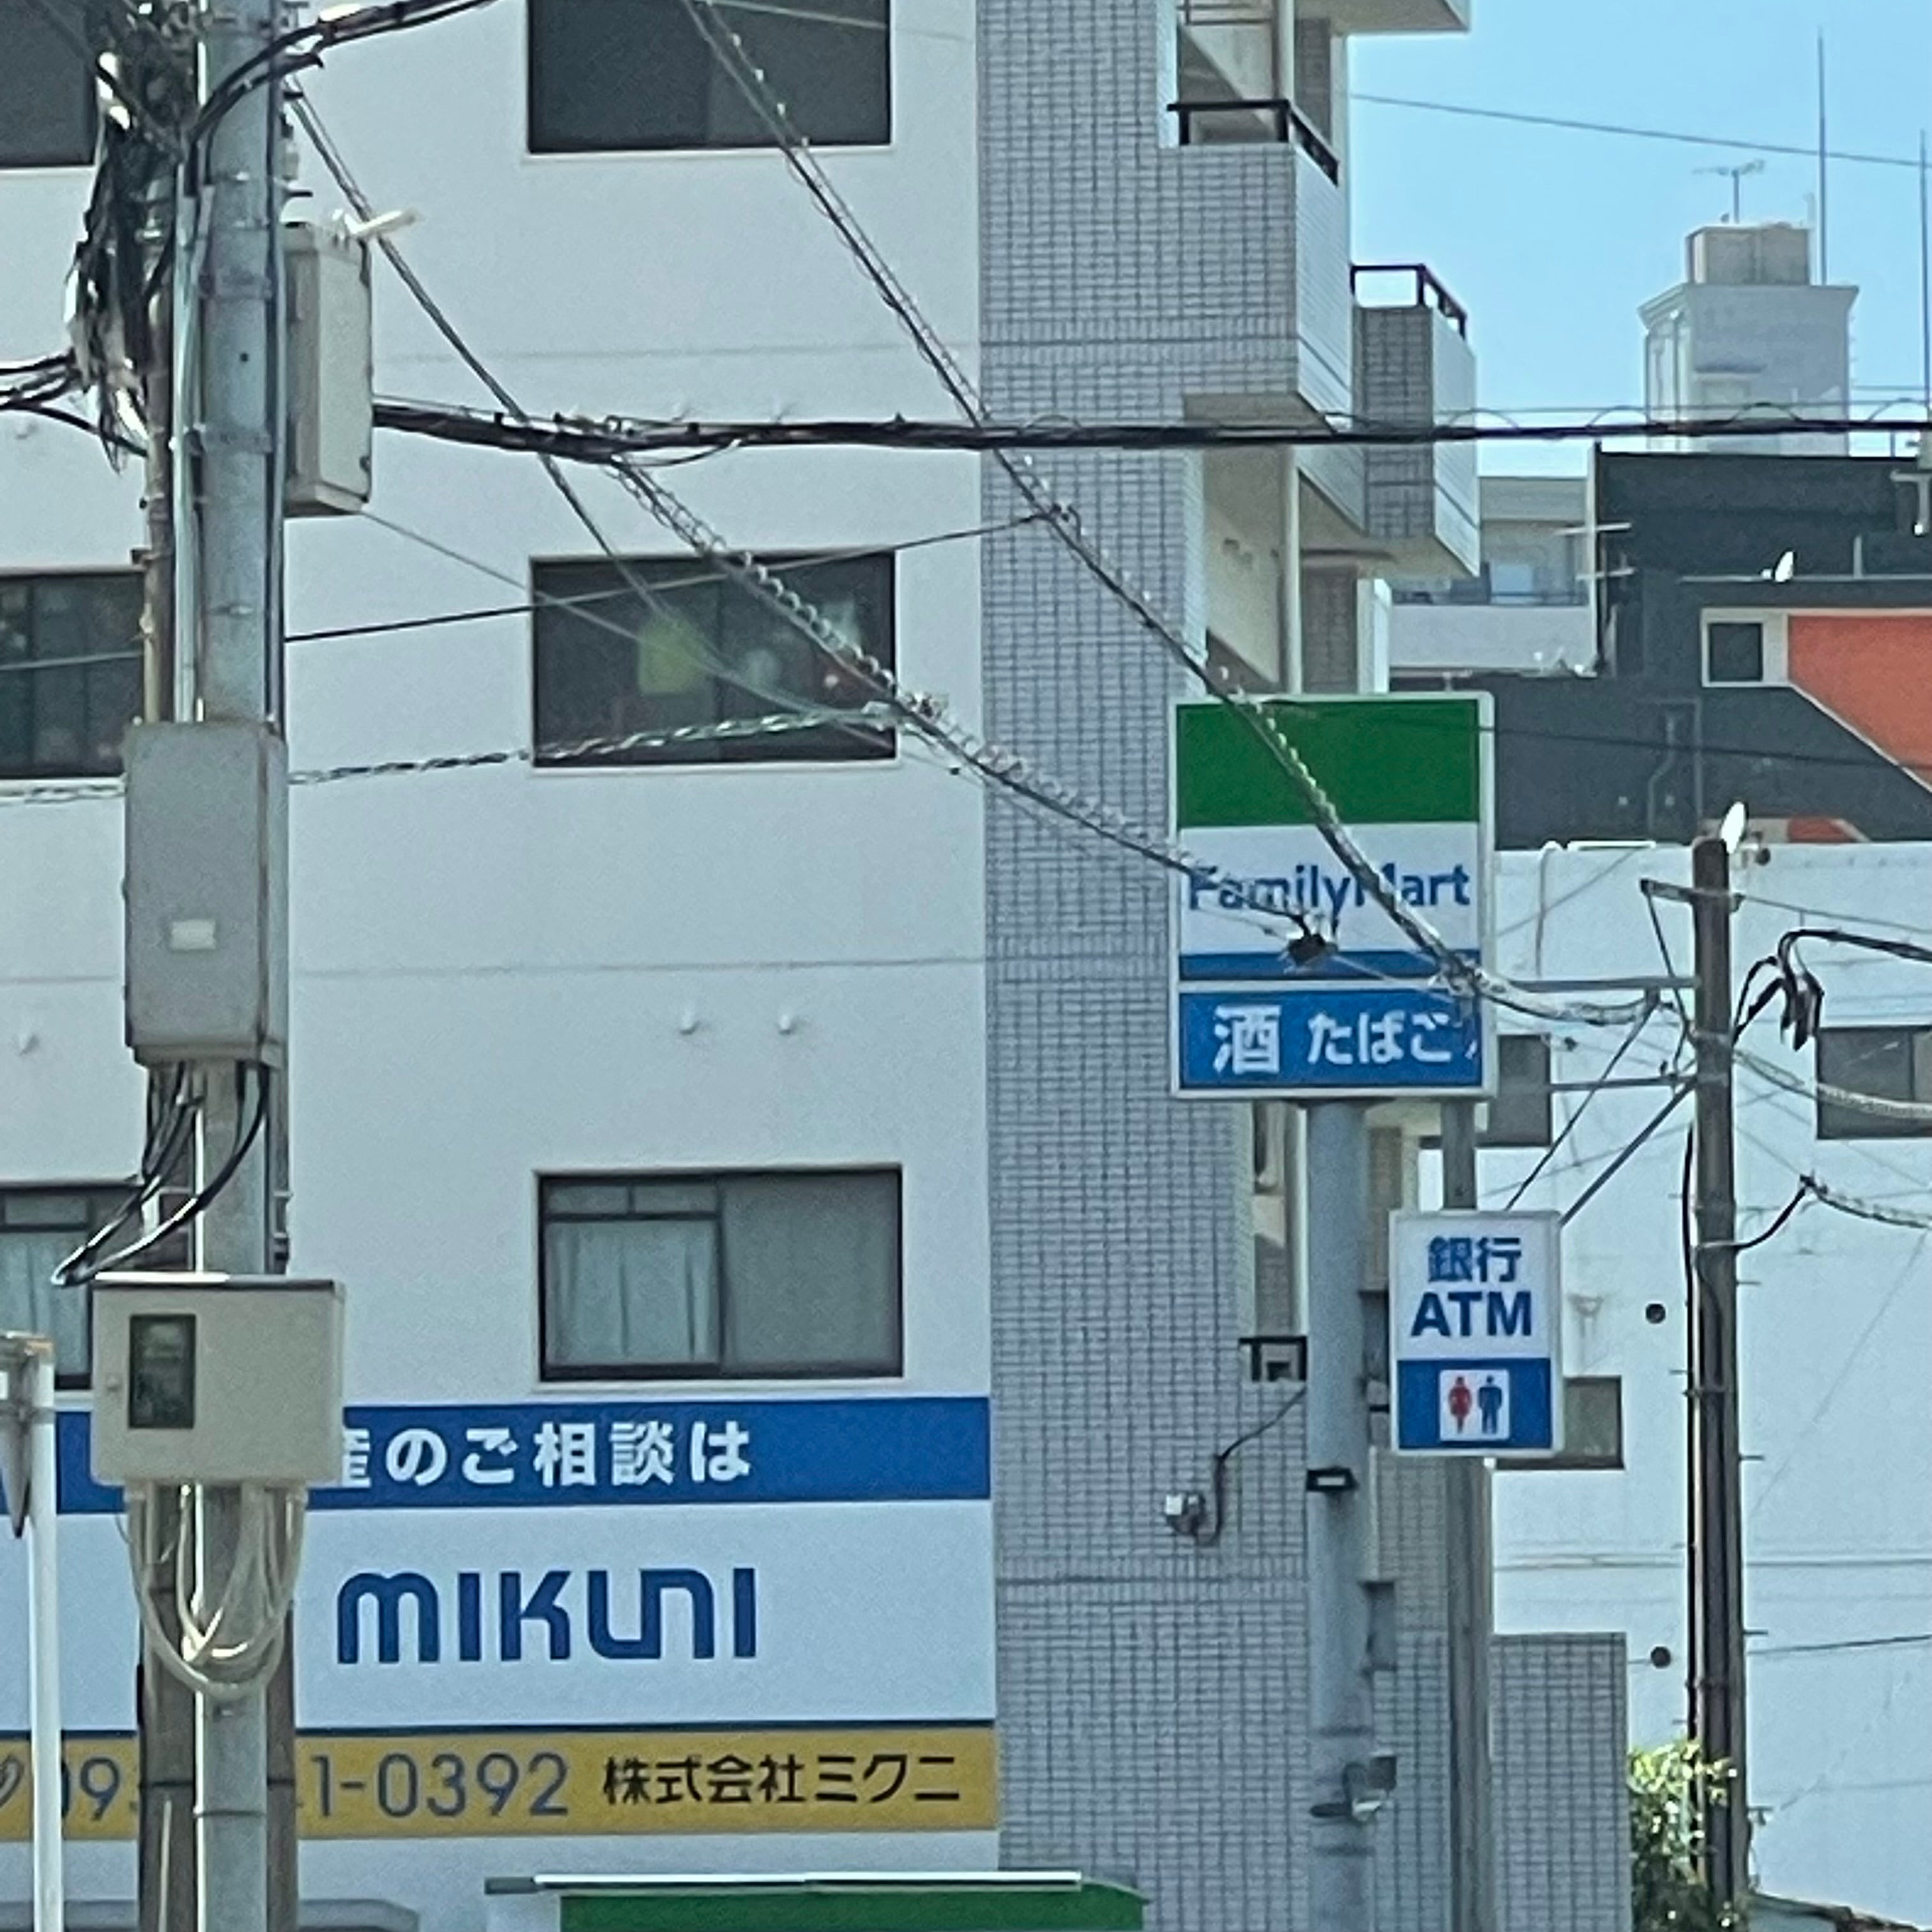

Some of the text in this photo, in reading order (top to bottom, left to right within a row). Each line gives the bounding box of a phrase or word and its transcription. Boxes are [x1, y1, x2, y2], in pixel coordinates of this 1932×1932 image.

[1214, 1004, 1452, 1075] 酒 たばこ
[1428, 1236, 1522, 1282] 銀行
[1411, 1291, 1531, 1337] ATM
[603, 1753, 960, 1805] 株式会社ミクニ
